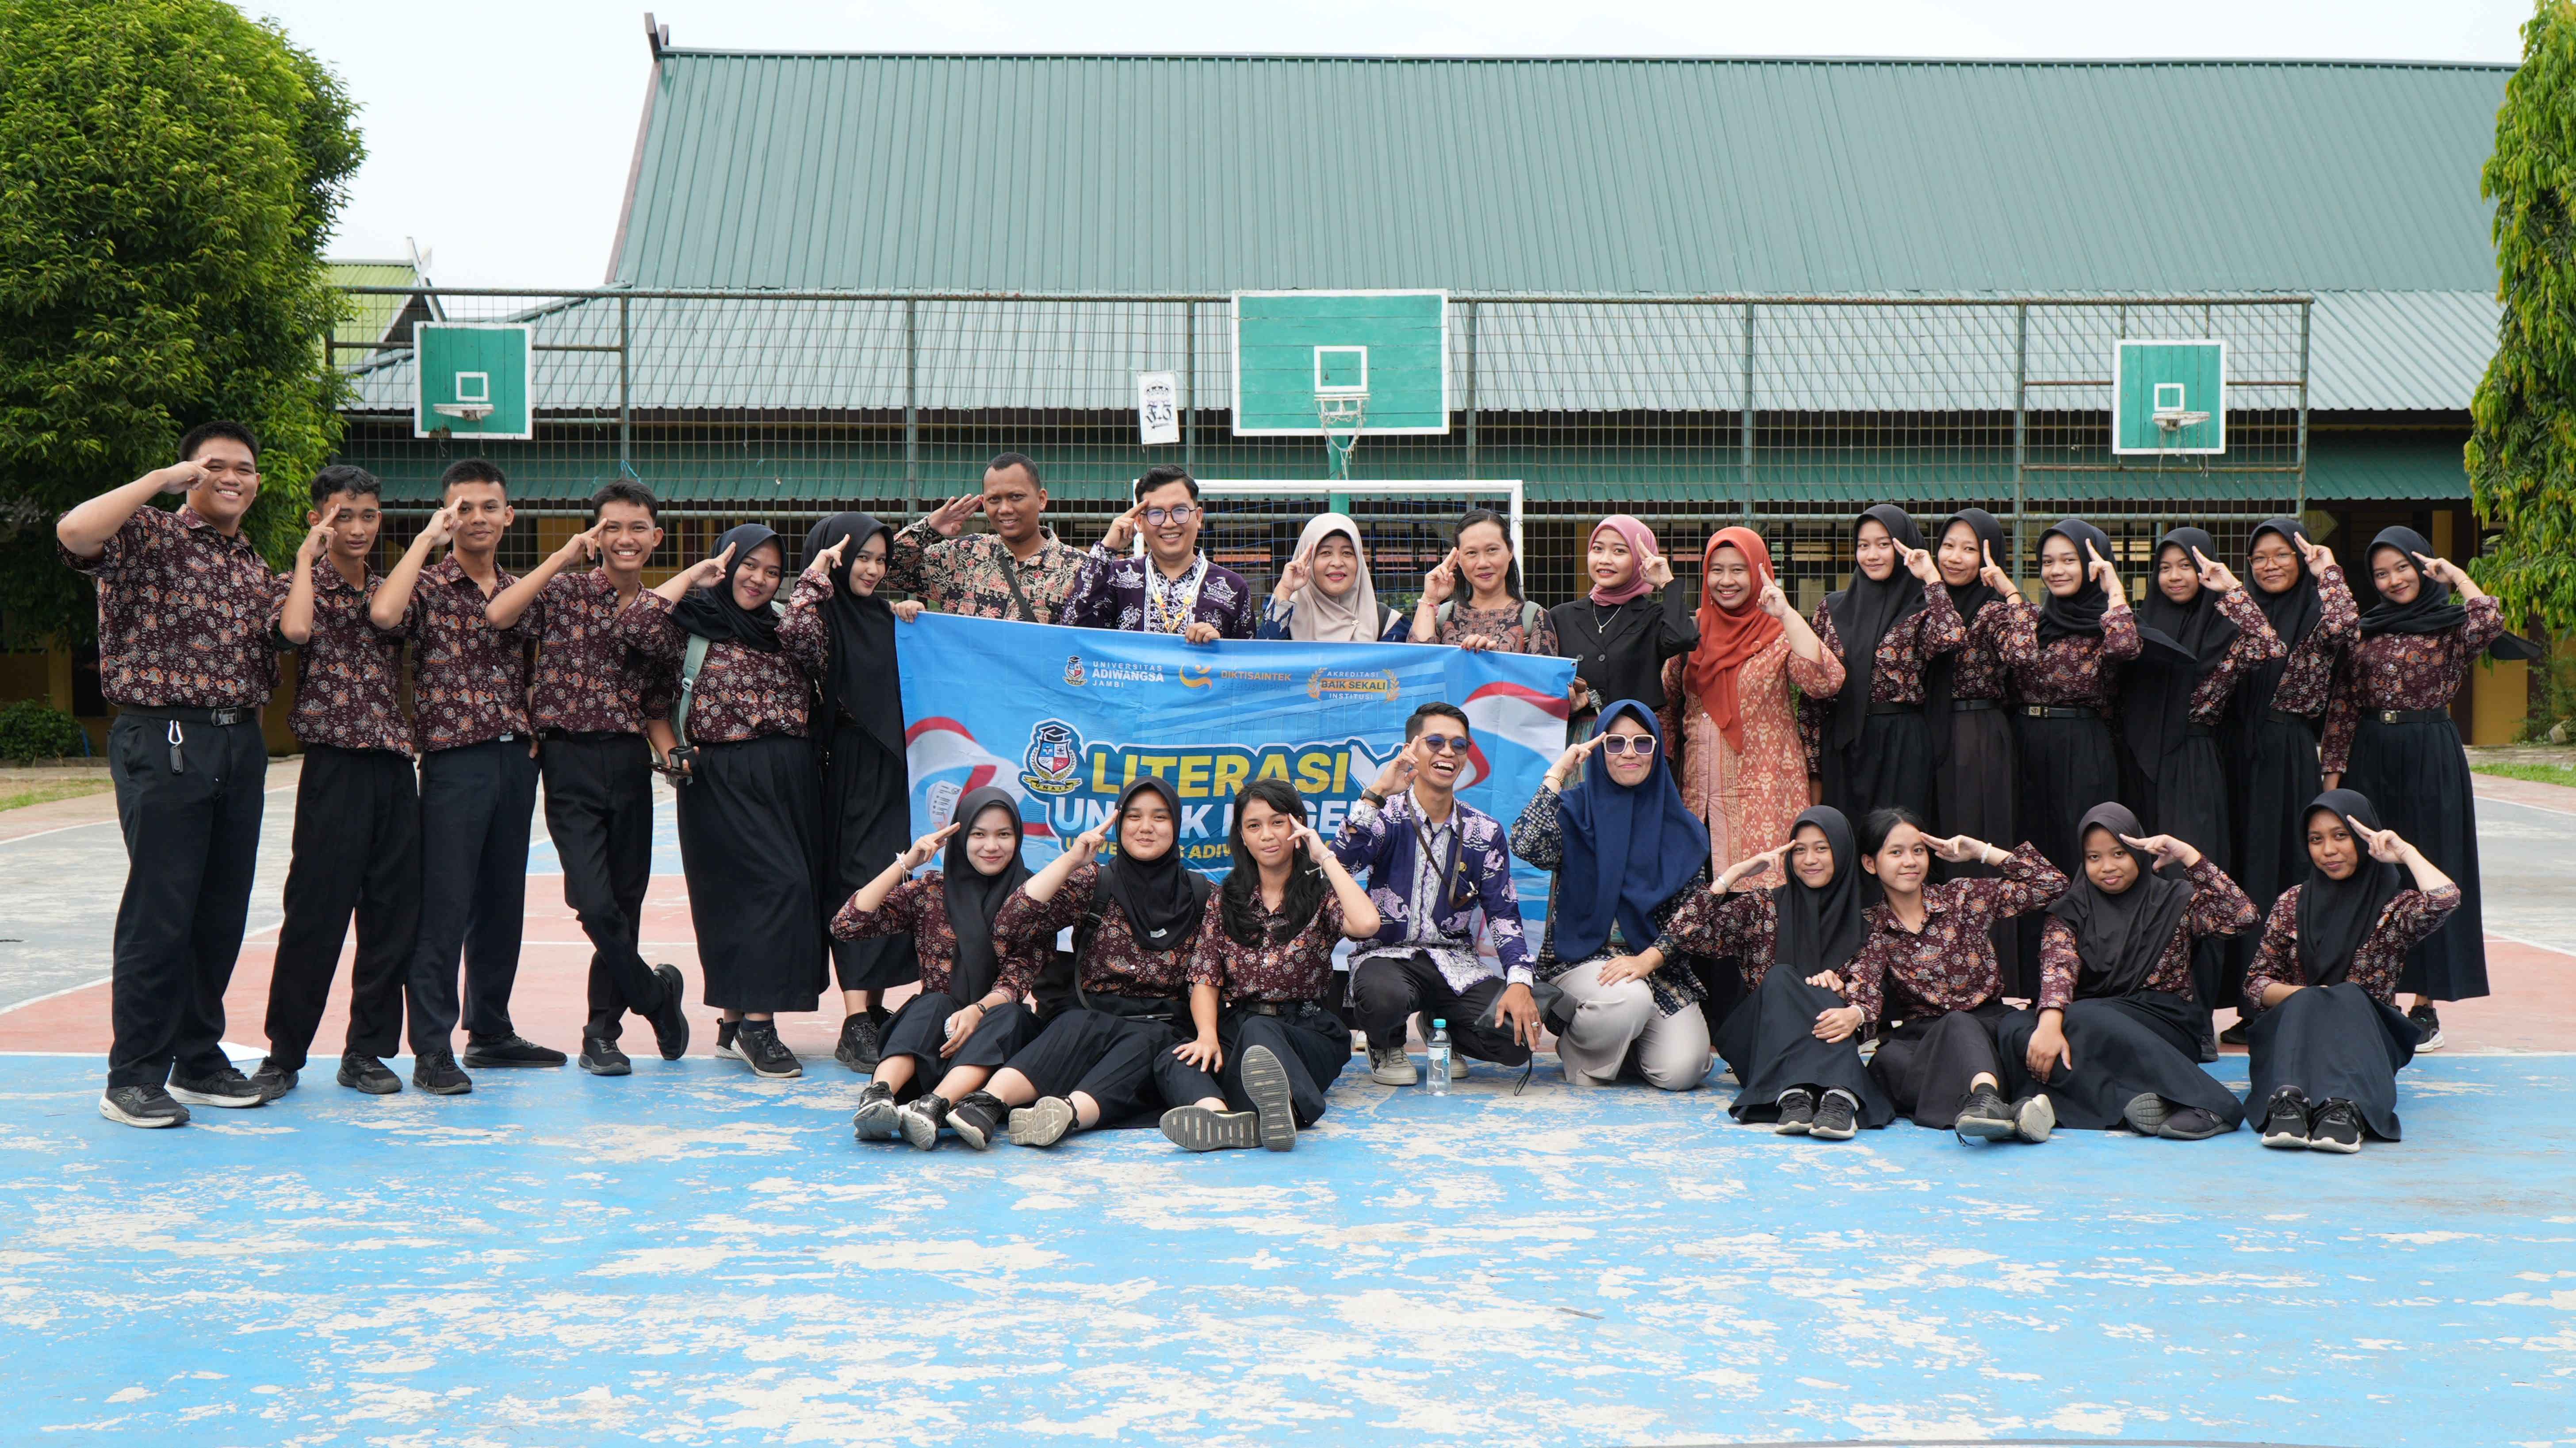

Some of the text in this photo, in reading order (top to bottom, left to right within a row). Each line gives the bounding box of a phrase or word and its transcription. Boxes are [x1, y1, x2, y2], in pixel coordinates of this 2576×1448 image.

[1093, 661, 1162, 671] UNIVERSITAS
[1092, 669, 1164, 682] ADIWANGSA
[1221, 670, 1291, 682] DIKTISAINTEK
[1321, 680, 1385, 690] BAIK SEKALI
[1092, 751, 1349, 797] LITERASI
[1054, 797, 1213, 839] UNK
